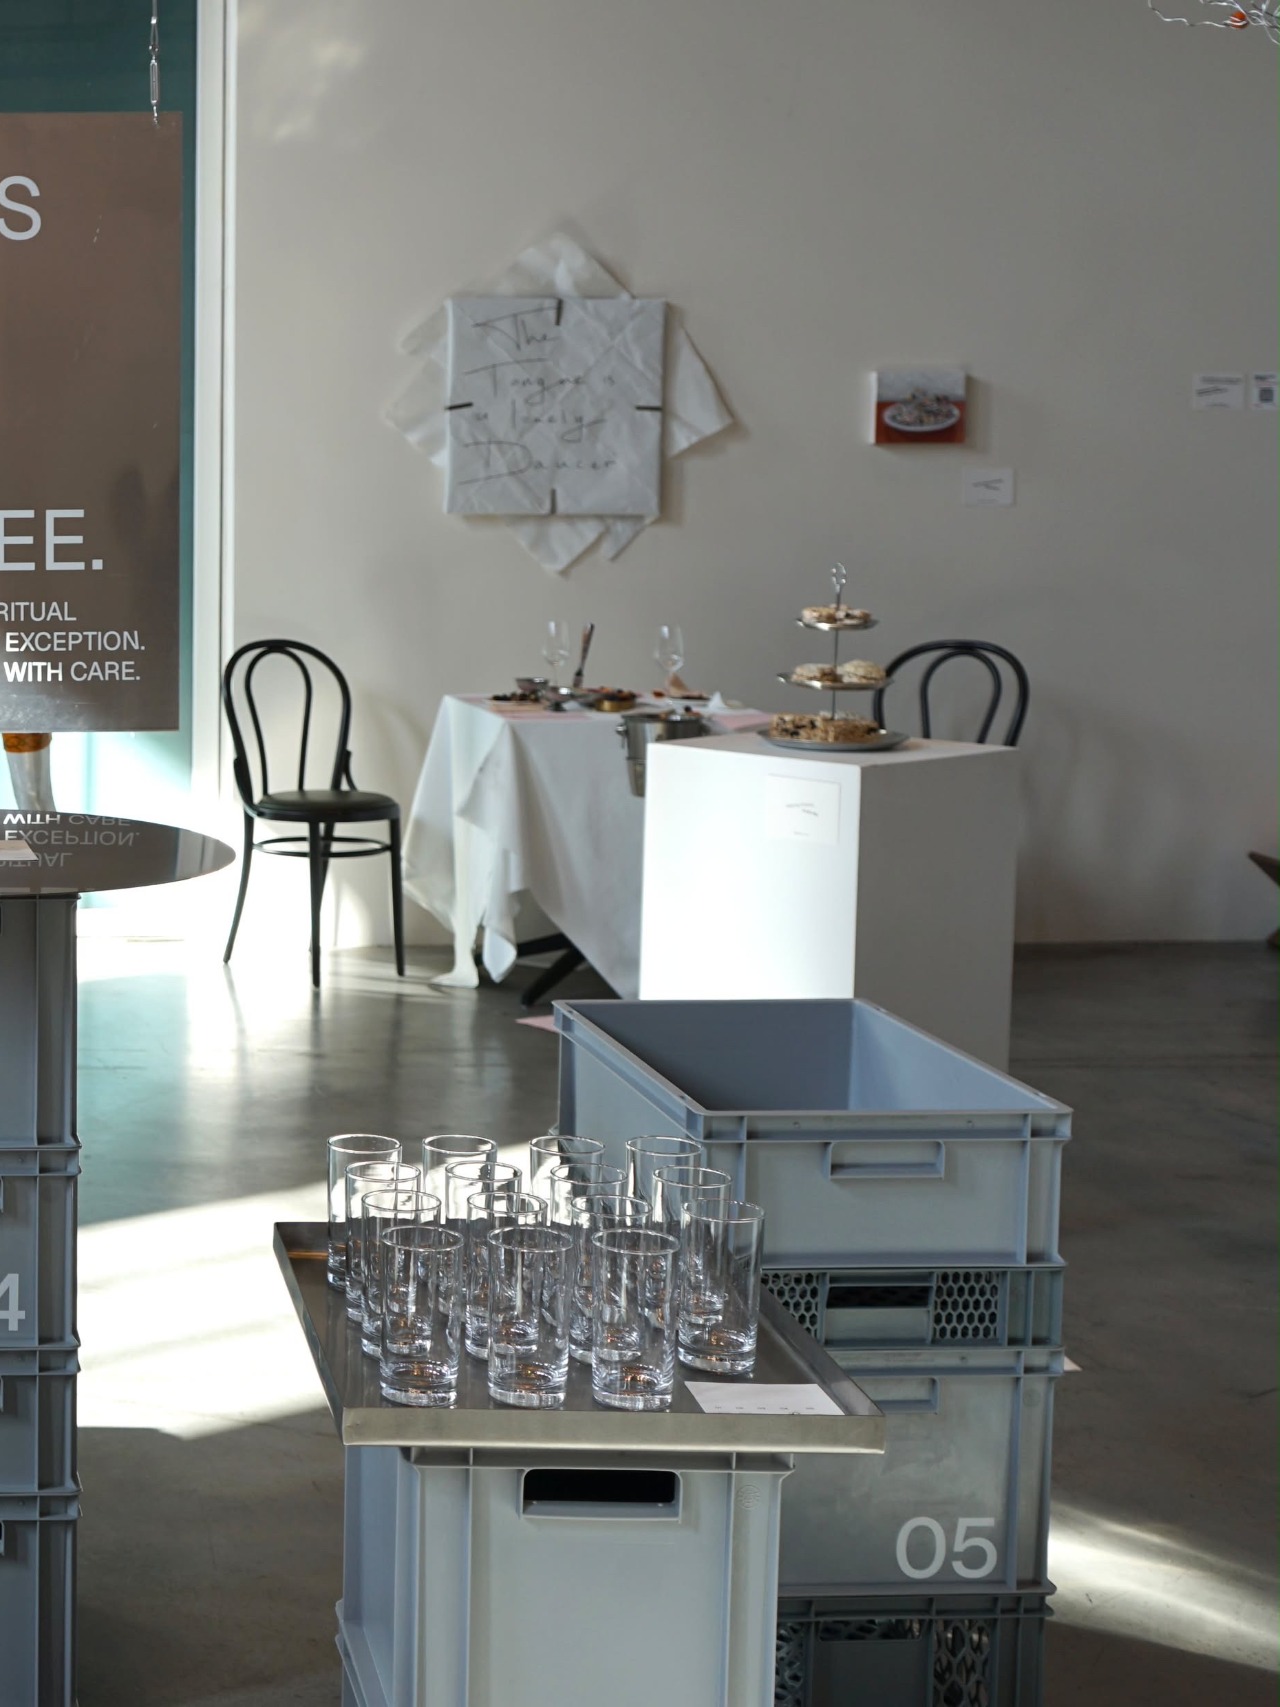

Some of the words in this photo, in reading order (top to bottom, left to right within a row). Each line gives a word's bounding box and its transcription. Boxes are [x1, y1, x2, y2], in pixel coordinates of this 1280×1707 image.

[5, 631, 145, 652] EXCEPTION.
[3, 662, 63, 682] WITH
[70, 661, 141, 682] CARE.
[895, 1516, 998, 1581] 05
